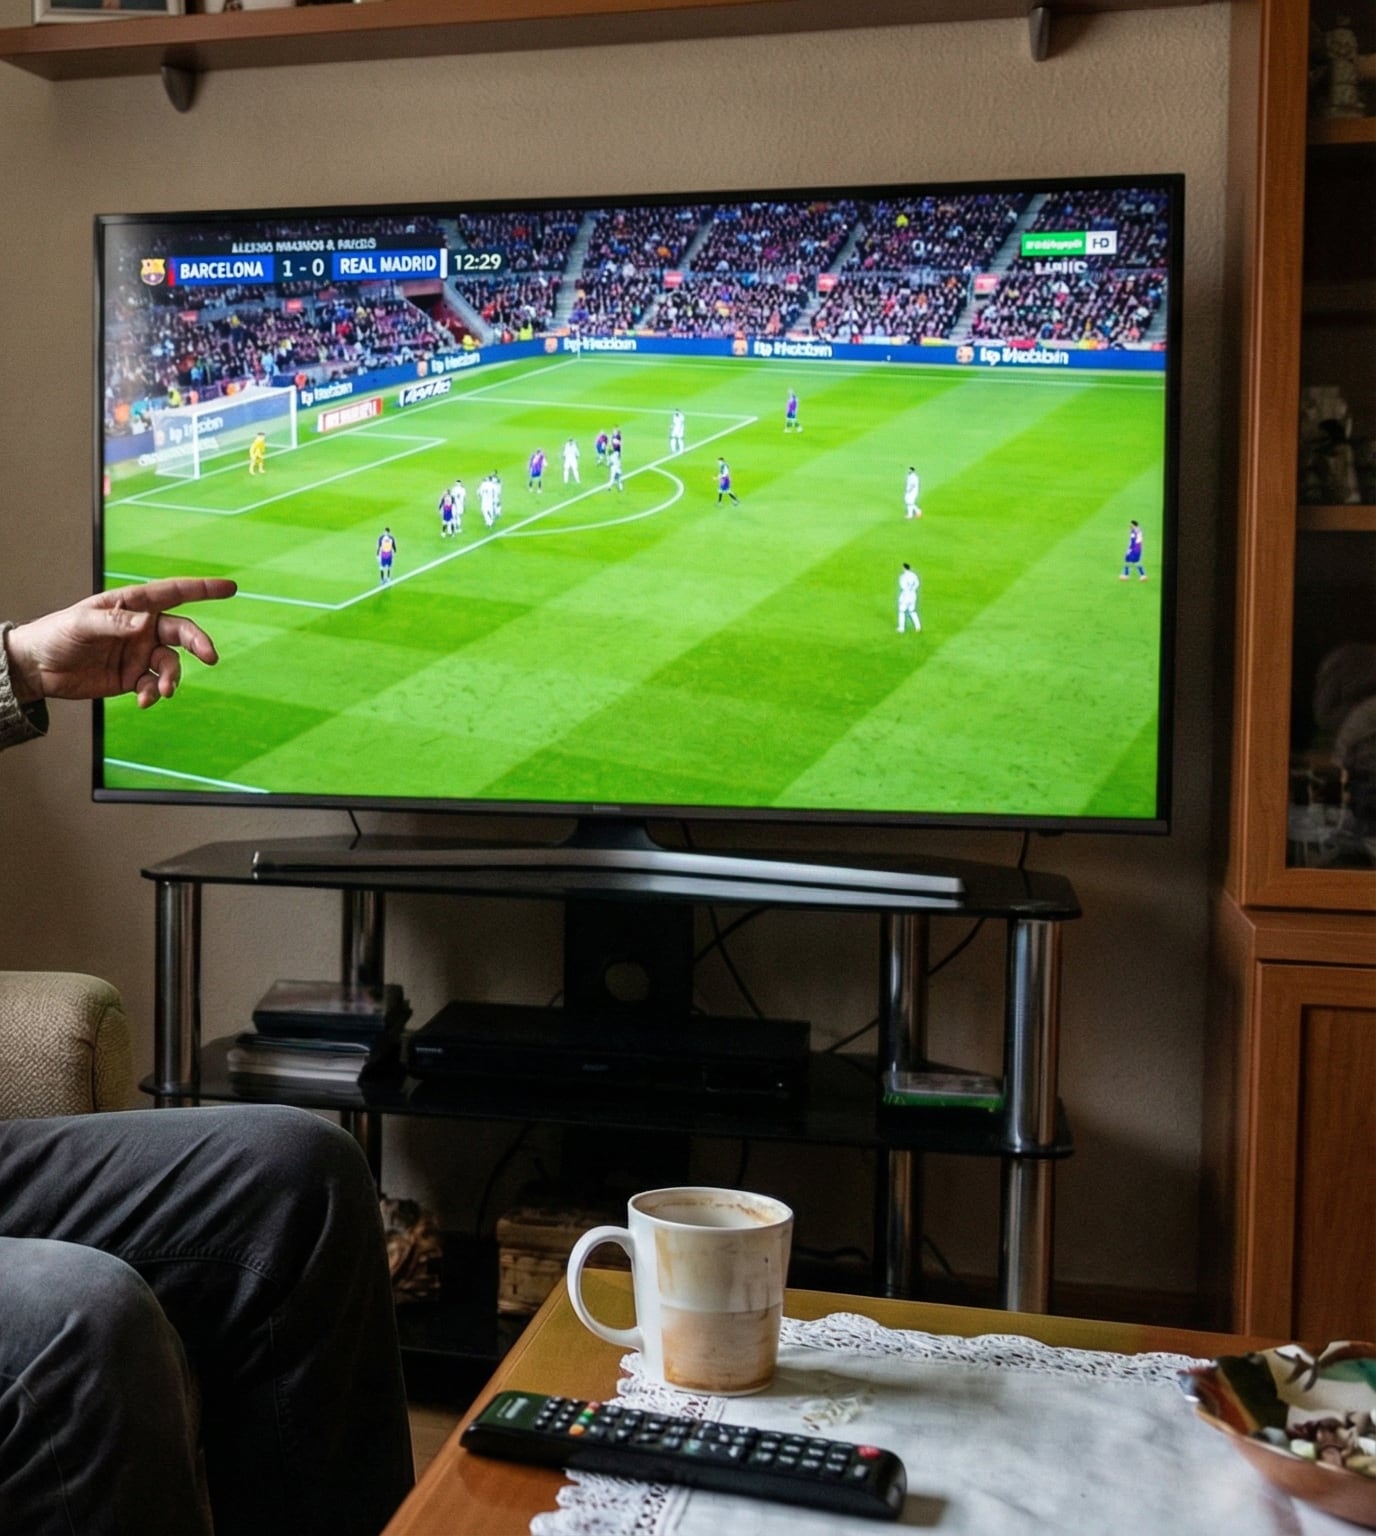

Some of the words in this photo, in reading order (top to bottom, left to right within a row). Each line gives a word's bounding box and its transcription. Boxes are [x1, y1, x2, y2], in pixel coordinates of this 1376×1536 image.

[1093, 238, 1109, 248] HD
[180, 261, 264, 279] BARCELONA
[282, 260, 293, 277] 1
[312, 258, 325, 276] 0
[340, 257, 376, 274] REAL
[380, 255, 436, 272] MADRID
[454, 253, 502, 271] 12:29
